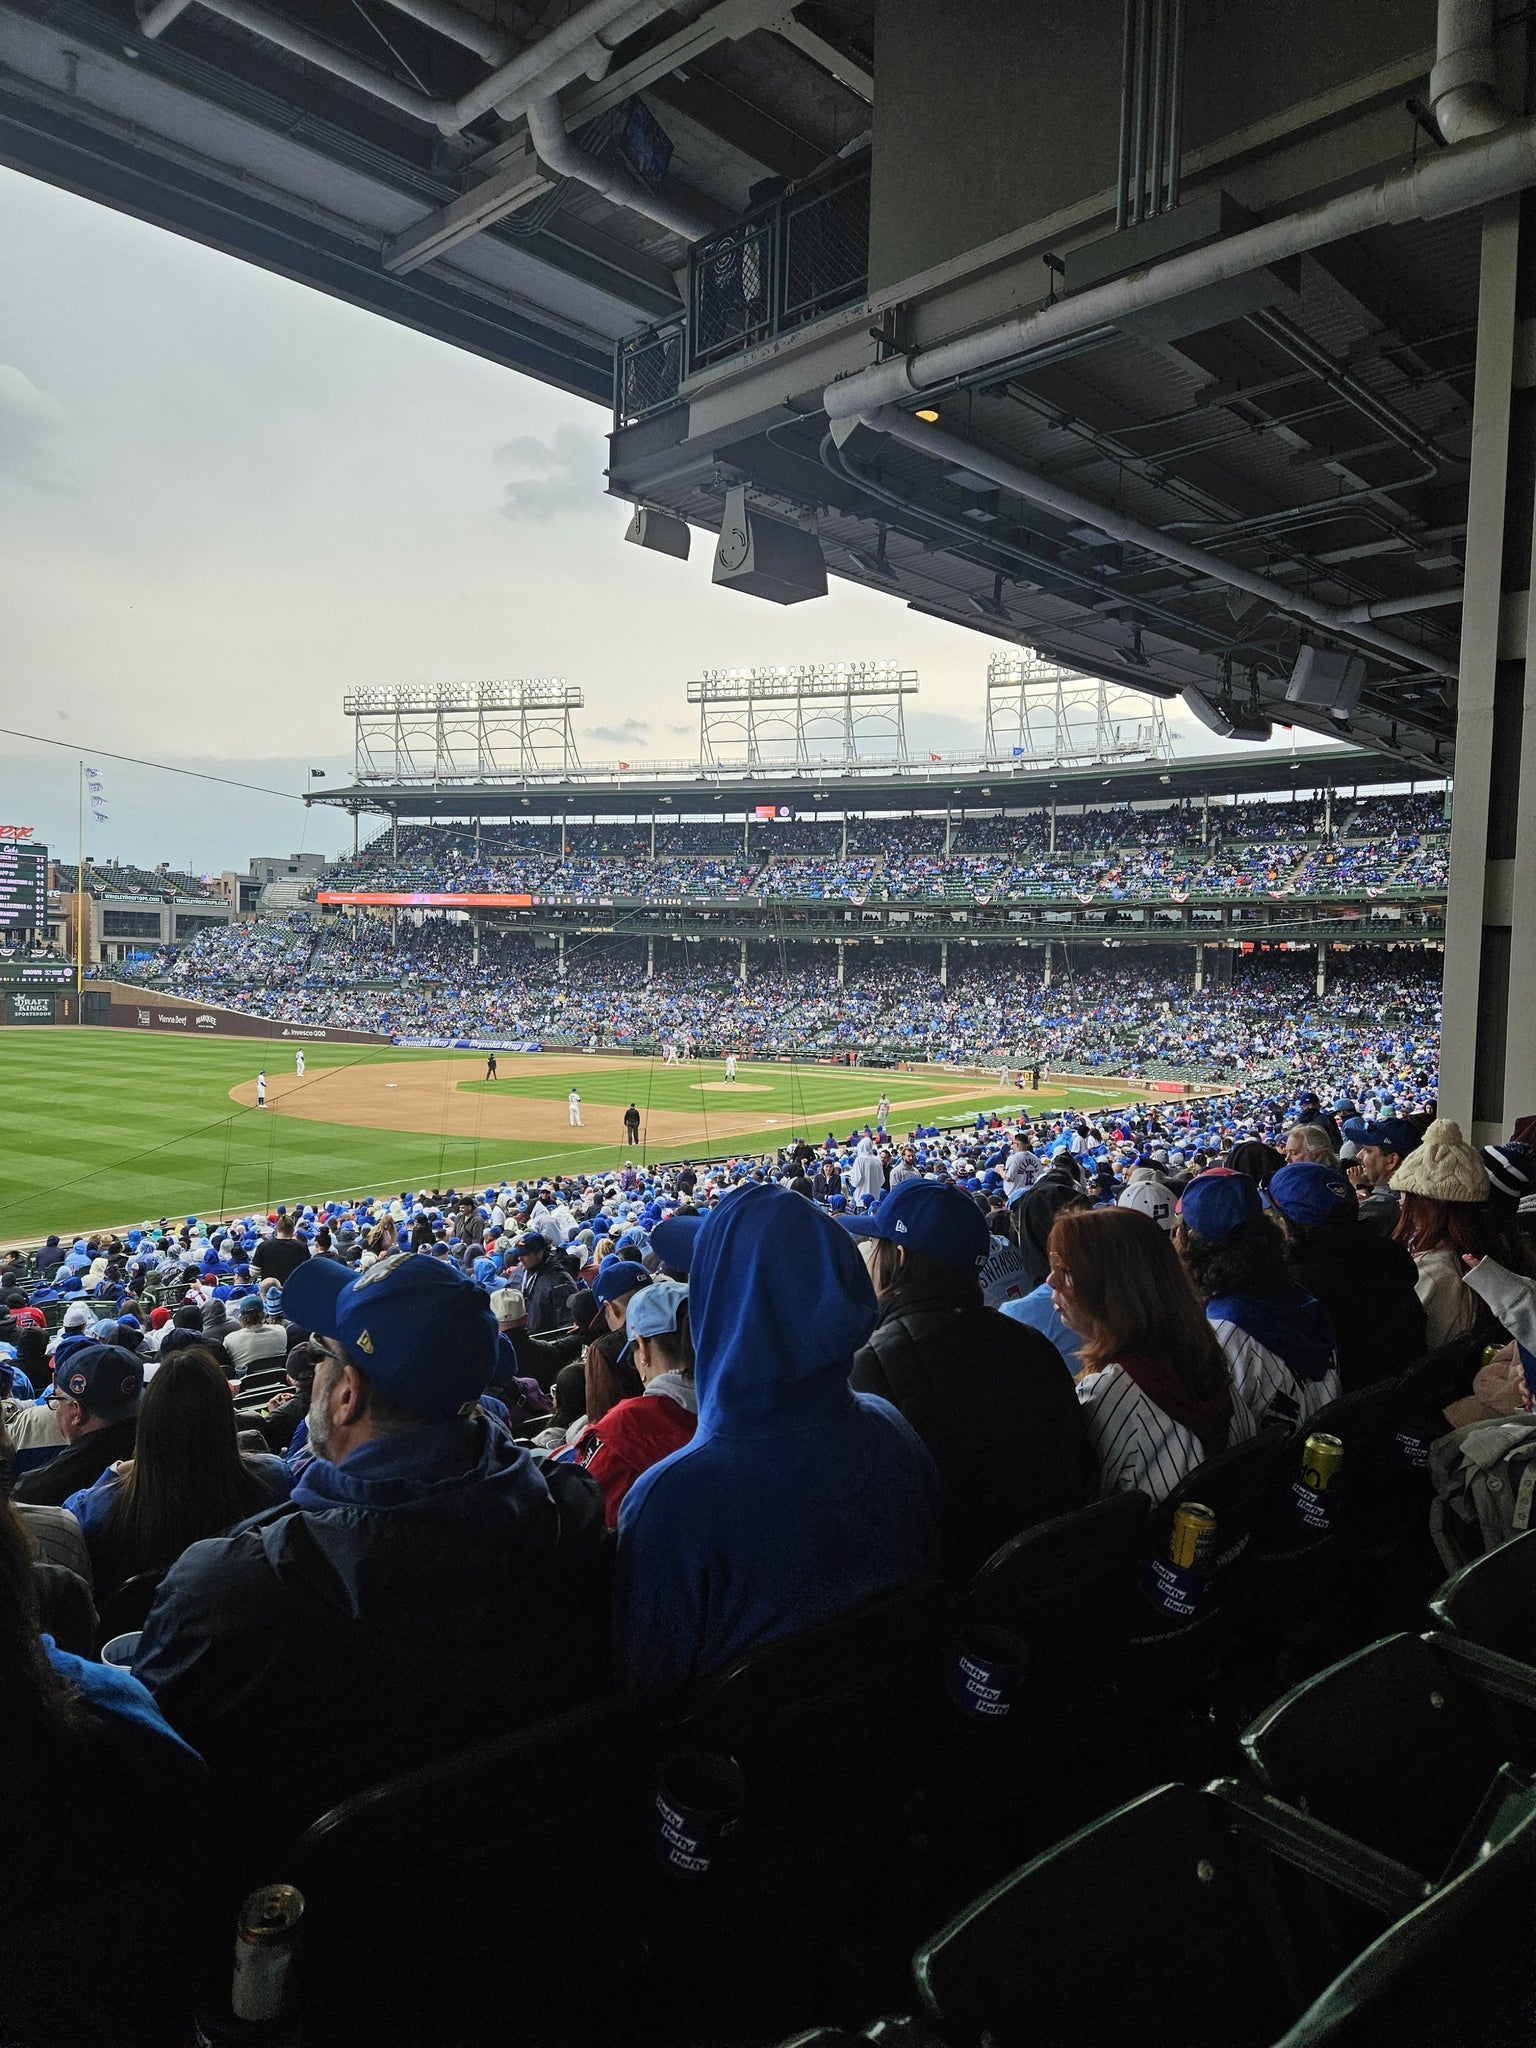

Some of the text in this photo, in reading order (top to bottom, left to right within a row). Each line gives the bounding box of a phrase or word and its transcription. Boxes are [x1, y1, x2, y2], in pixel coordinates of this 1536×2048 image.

[158, 1014, 174, 1024] Vienna
[175, 1015, 187, 1026] Beef
[399, 1038, 449, 1048] Reynolds Wrap
[469, 1040, 522, 1050] Reynolds Wrap
[1292, 1483, 1317, 1502] Hefty
[1297, 1499, 1324, 1516] Hefty
[1304, 1514, 1330, 1528] Hefty
[1152, 1560, 1178, 1583] Hefty
[1158, 1580, 1187, 1600] Hefty
[1164, 1598, 1195, 1615] Hefty
[960, 1657, 990, 1683] Hefty
[966, 1680, 1002, 1701] Hefty
[976, 1700, 1010, 1716] Hefty
[656, 1795, 683, 1830] Hefty
[662, 1824, 697, 1853] Hefty
[671, 1849, 711, 1872] Hefty
